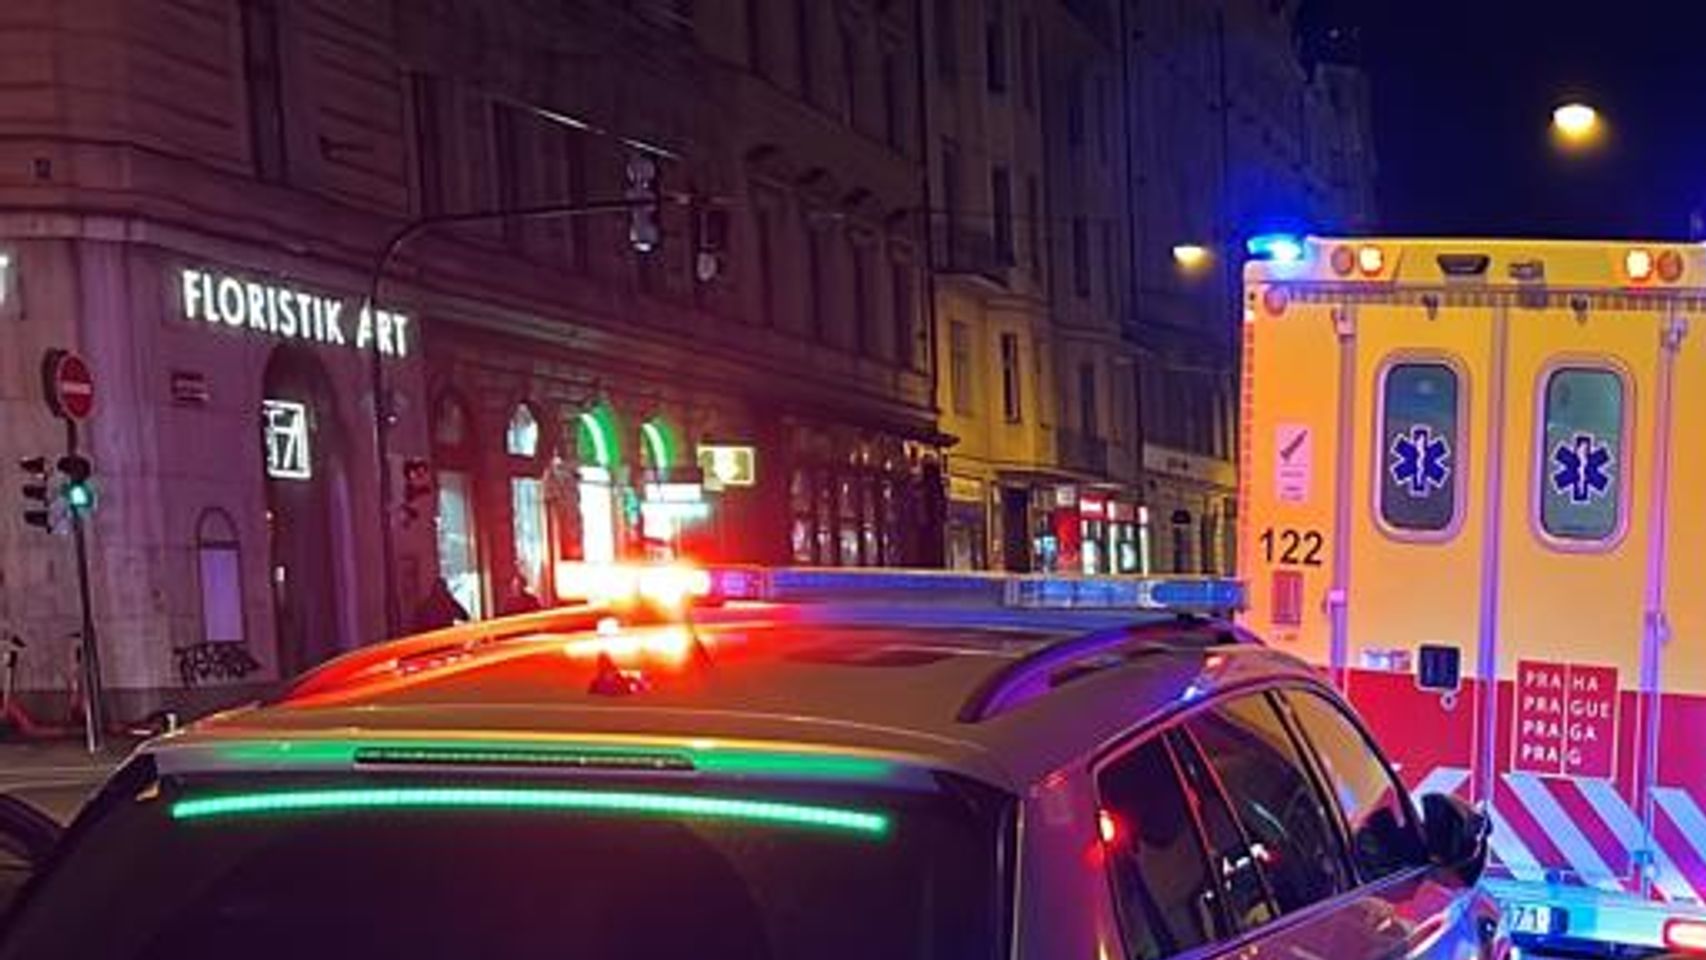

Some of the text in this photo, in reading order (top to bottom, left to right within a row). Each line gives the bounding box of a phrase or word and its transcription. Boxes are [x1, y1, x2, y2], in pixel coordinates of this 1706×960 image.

[183, 269, 408, 357] FLORISTIK ART
[1260, 528, 1323, 567] 122
